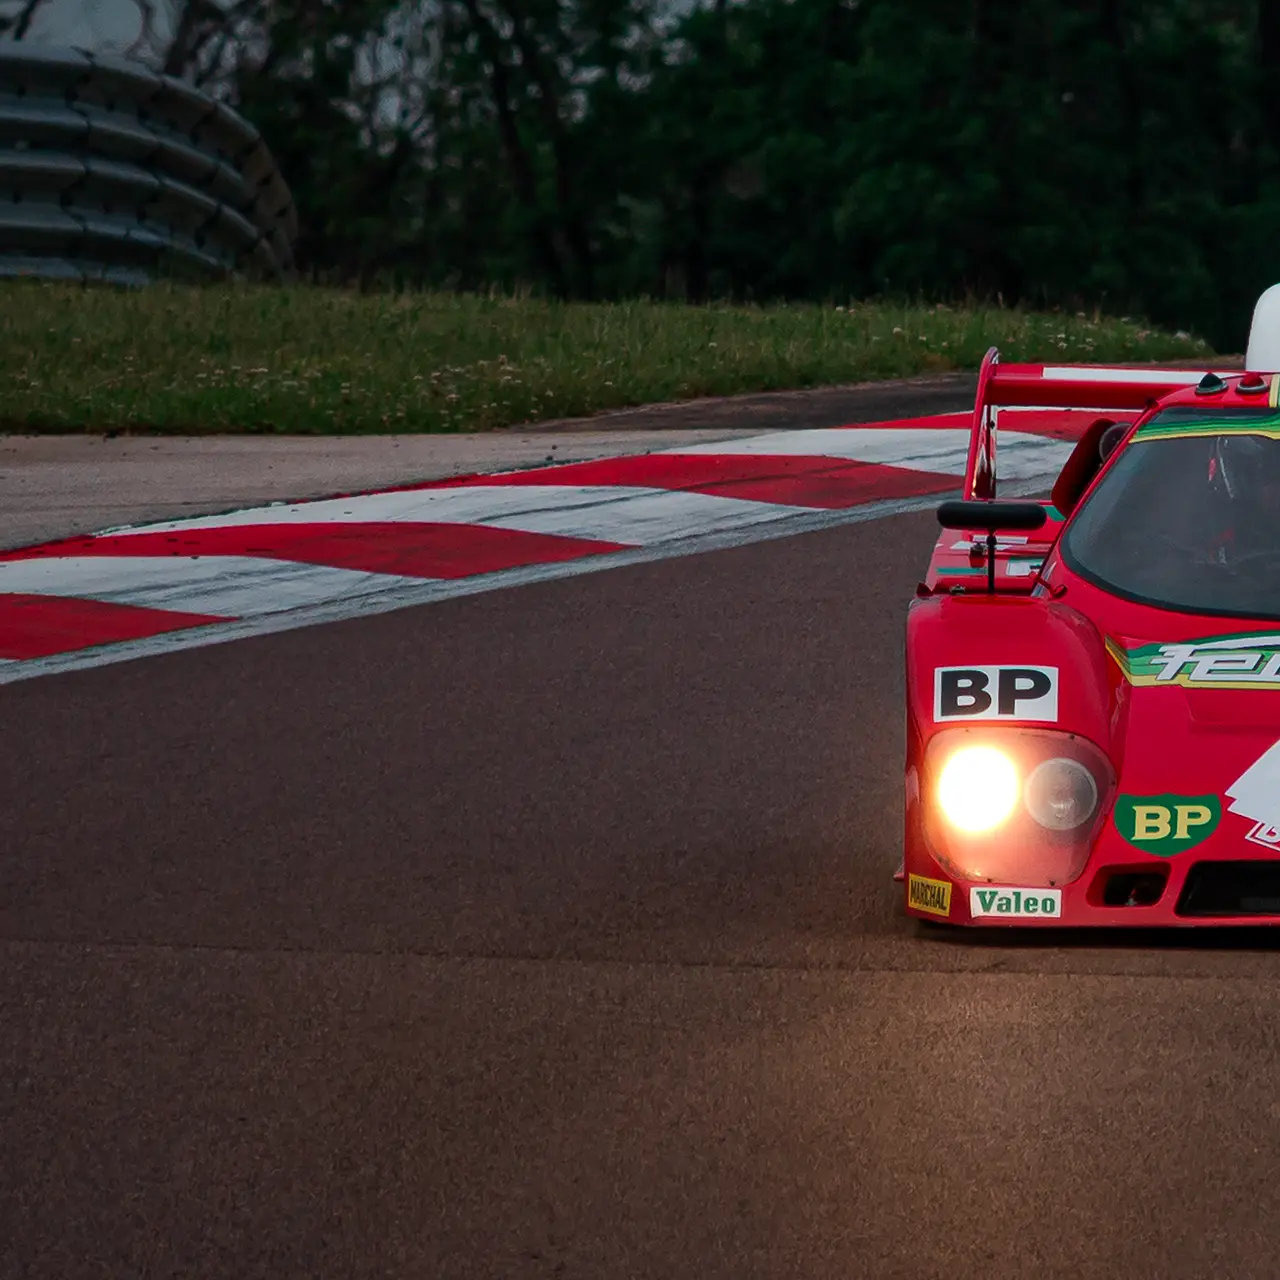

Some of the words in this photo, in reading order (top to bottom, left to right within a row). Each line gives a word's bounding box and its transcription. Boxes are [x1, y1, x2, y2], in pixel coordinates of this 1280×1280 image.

[940, 669, 1051, 717] BP
[1130, 805, 1212, 841] BP
[910, 879, 947, 911] MARCHAL
[976, 891, 1056, 914] Valeo
